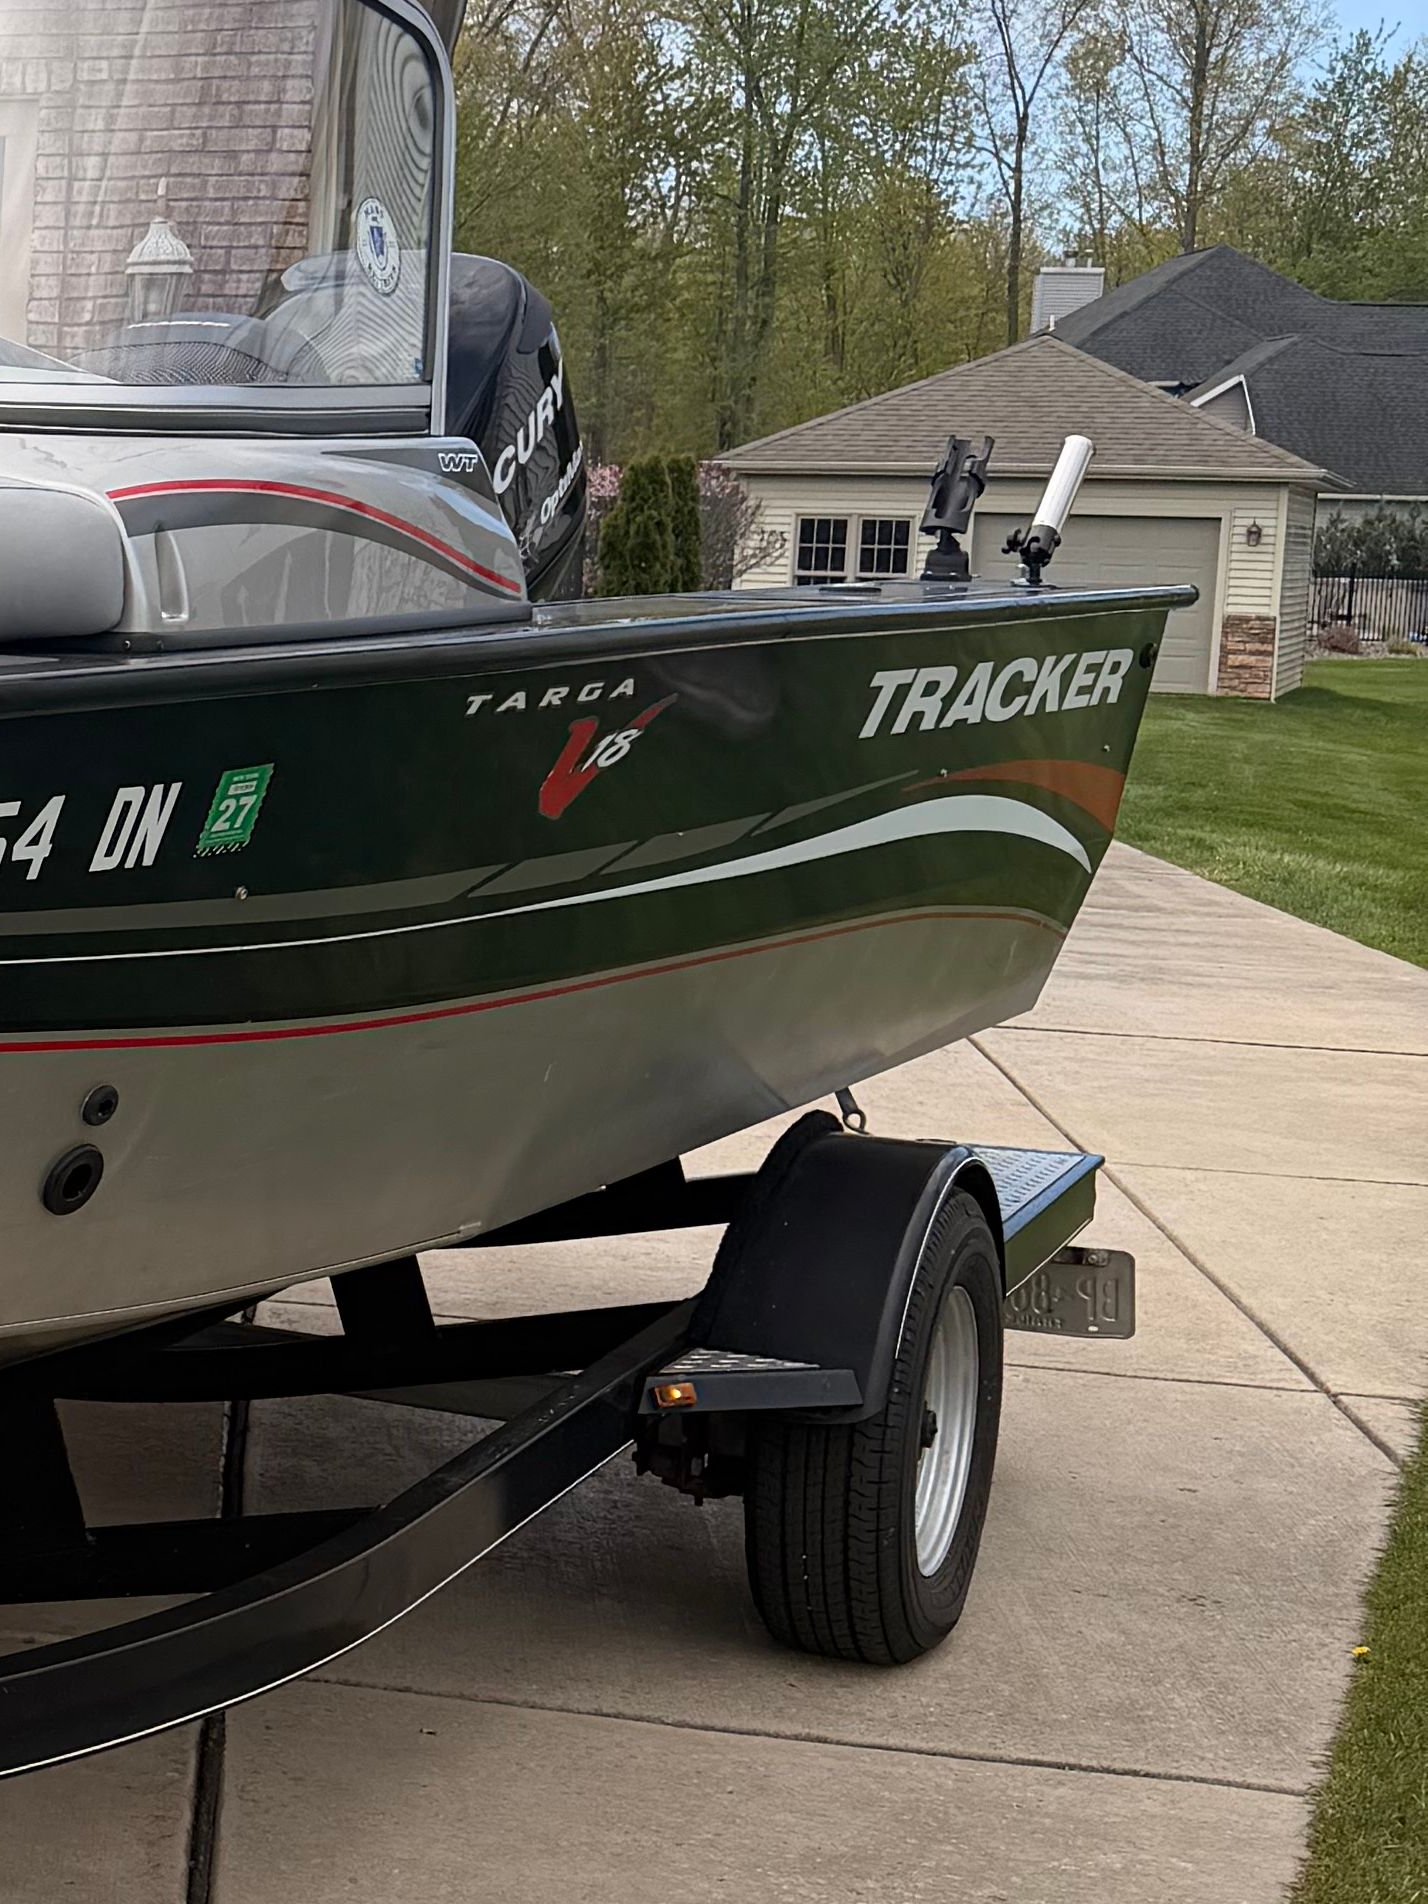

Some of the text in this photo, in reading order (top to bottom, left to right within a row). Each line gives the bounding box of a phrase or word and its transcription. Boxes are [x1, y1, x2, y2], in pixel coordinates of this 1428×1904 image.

[493, 357, 563, 494] CURY
[464, 677, 635, 716] TARGA
[857, 648, 1134, 739] TRACKER
[89, 781, 183, 872] DN
[210, 795, 258, 833] 27
